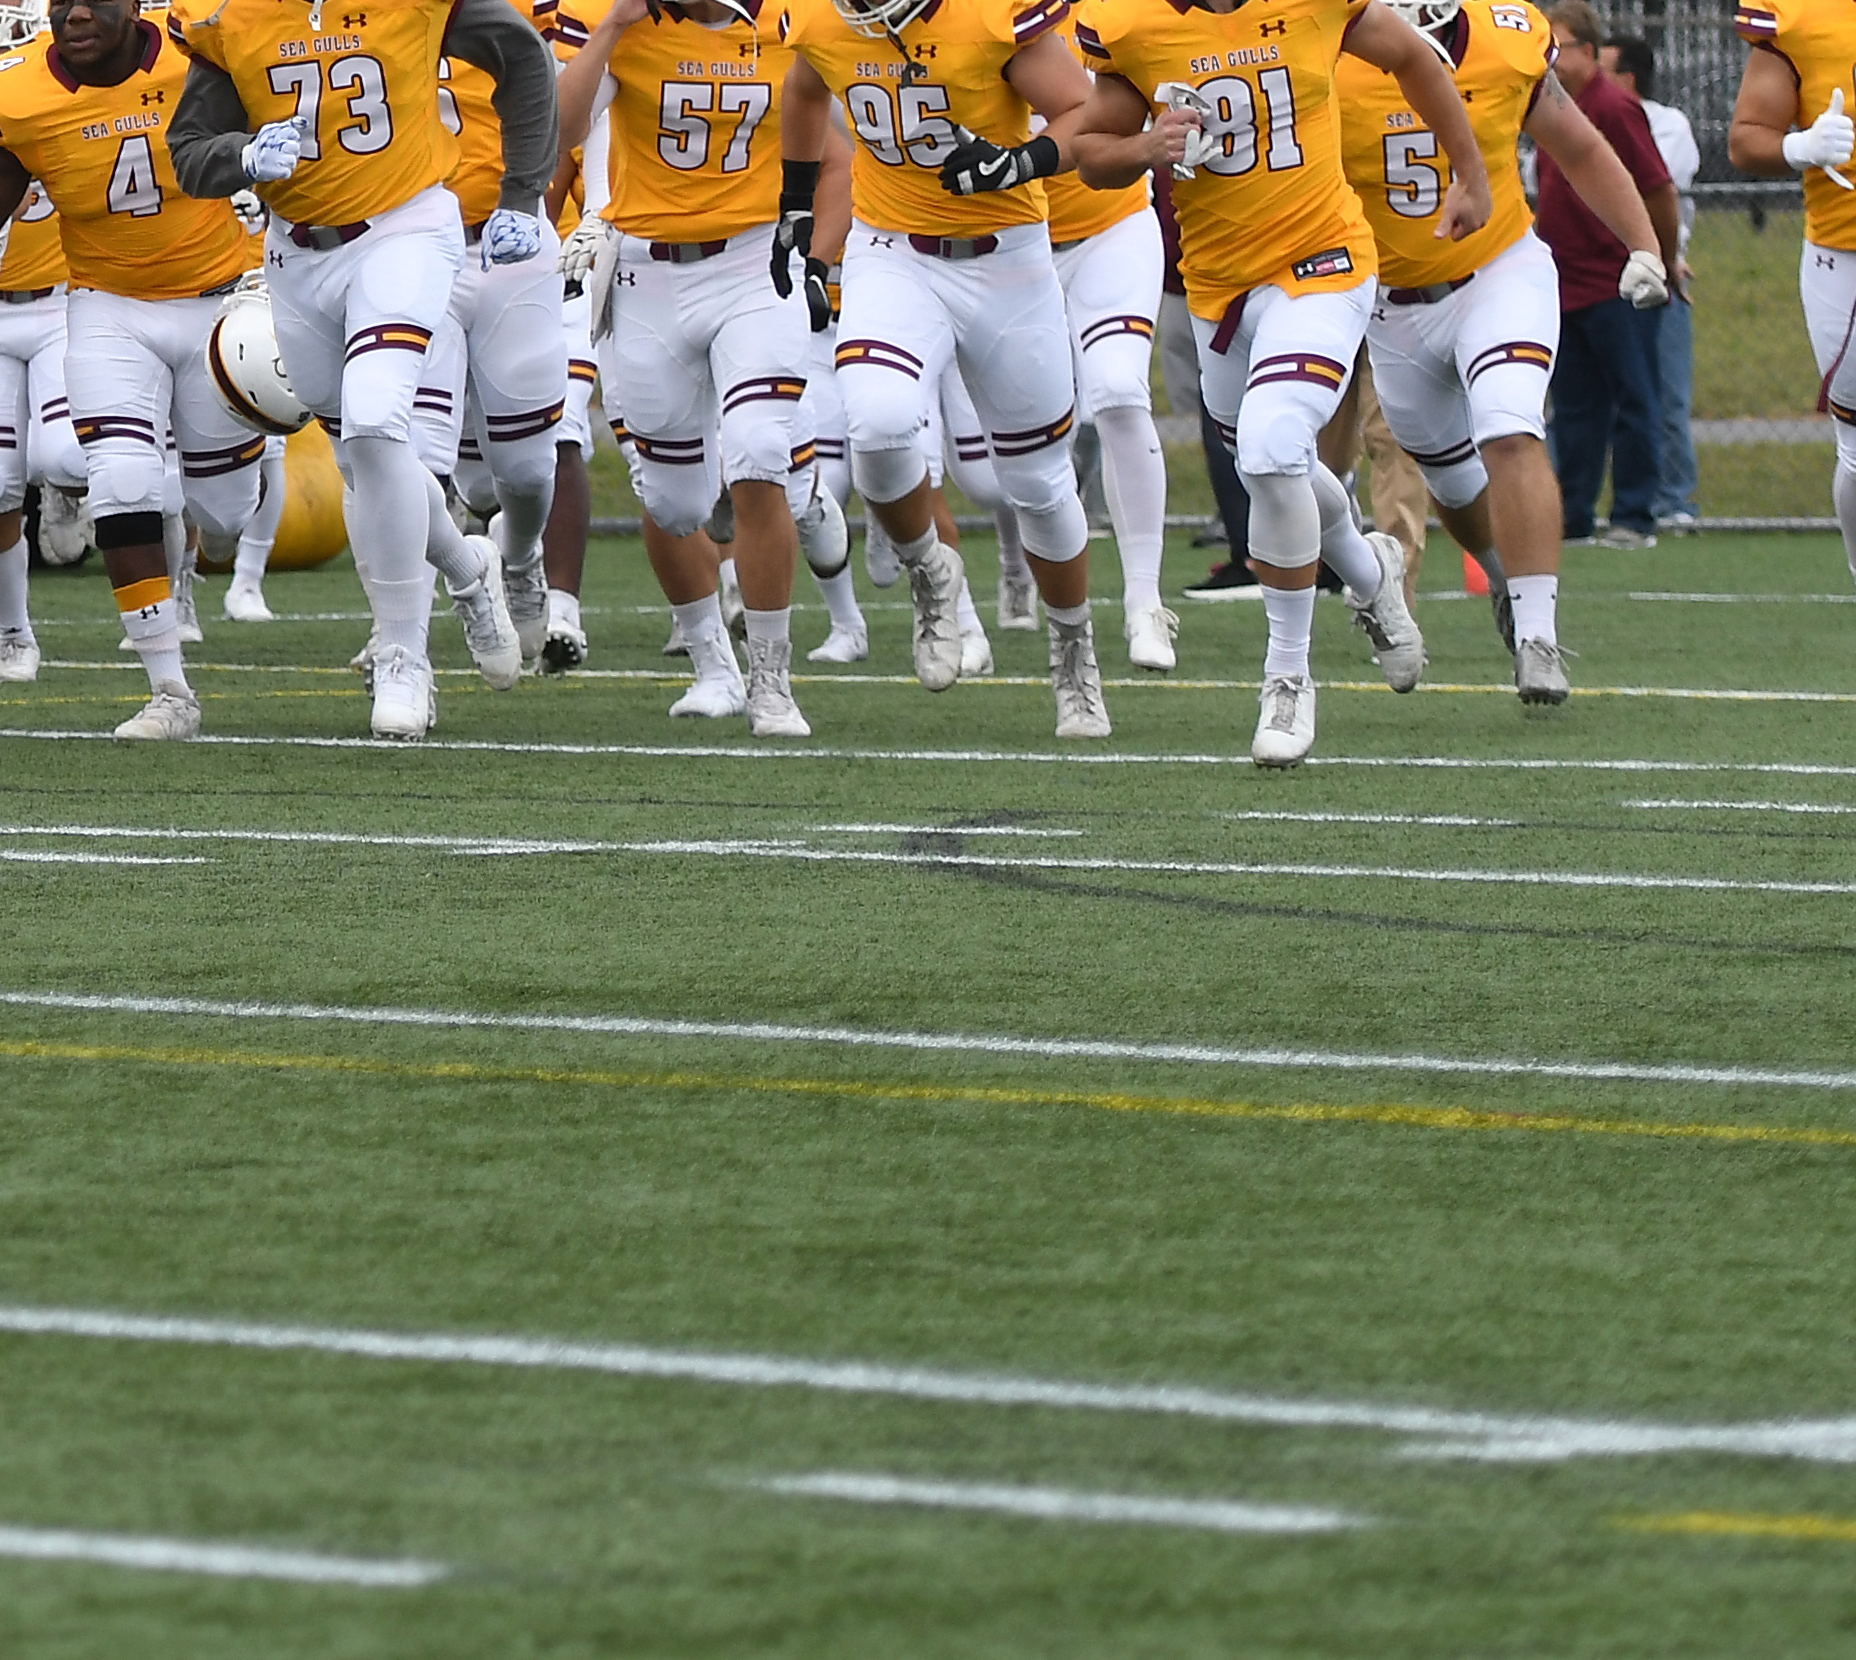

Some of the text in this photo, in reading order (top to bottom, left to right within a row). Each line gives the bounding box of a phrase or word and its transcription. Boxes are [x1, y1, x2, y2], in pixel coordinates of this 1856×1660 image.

[279, 34, 362, 58] SEA GULLS
[678, 61, 755, 77] SEA GULLS
[855, 62, 880, 76] SEA
[1190, 44, 1280, 75] SEA GULLS
[81, 111, 162, 141] SEA GULLS
[265, 54, 394, 162] 73
[656, 80, 772, 174] 57
[845, 82, 962, 167] 95
[1195, 64, 1304, 177] 81
[1386, 113, 1414, 128] SEA
[106, 134, 164, 218] 4
[1383, 130, 1454, 218] 5
